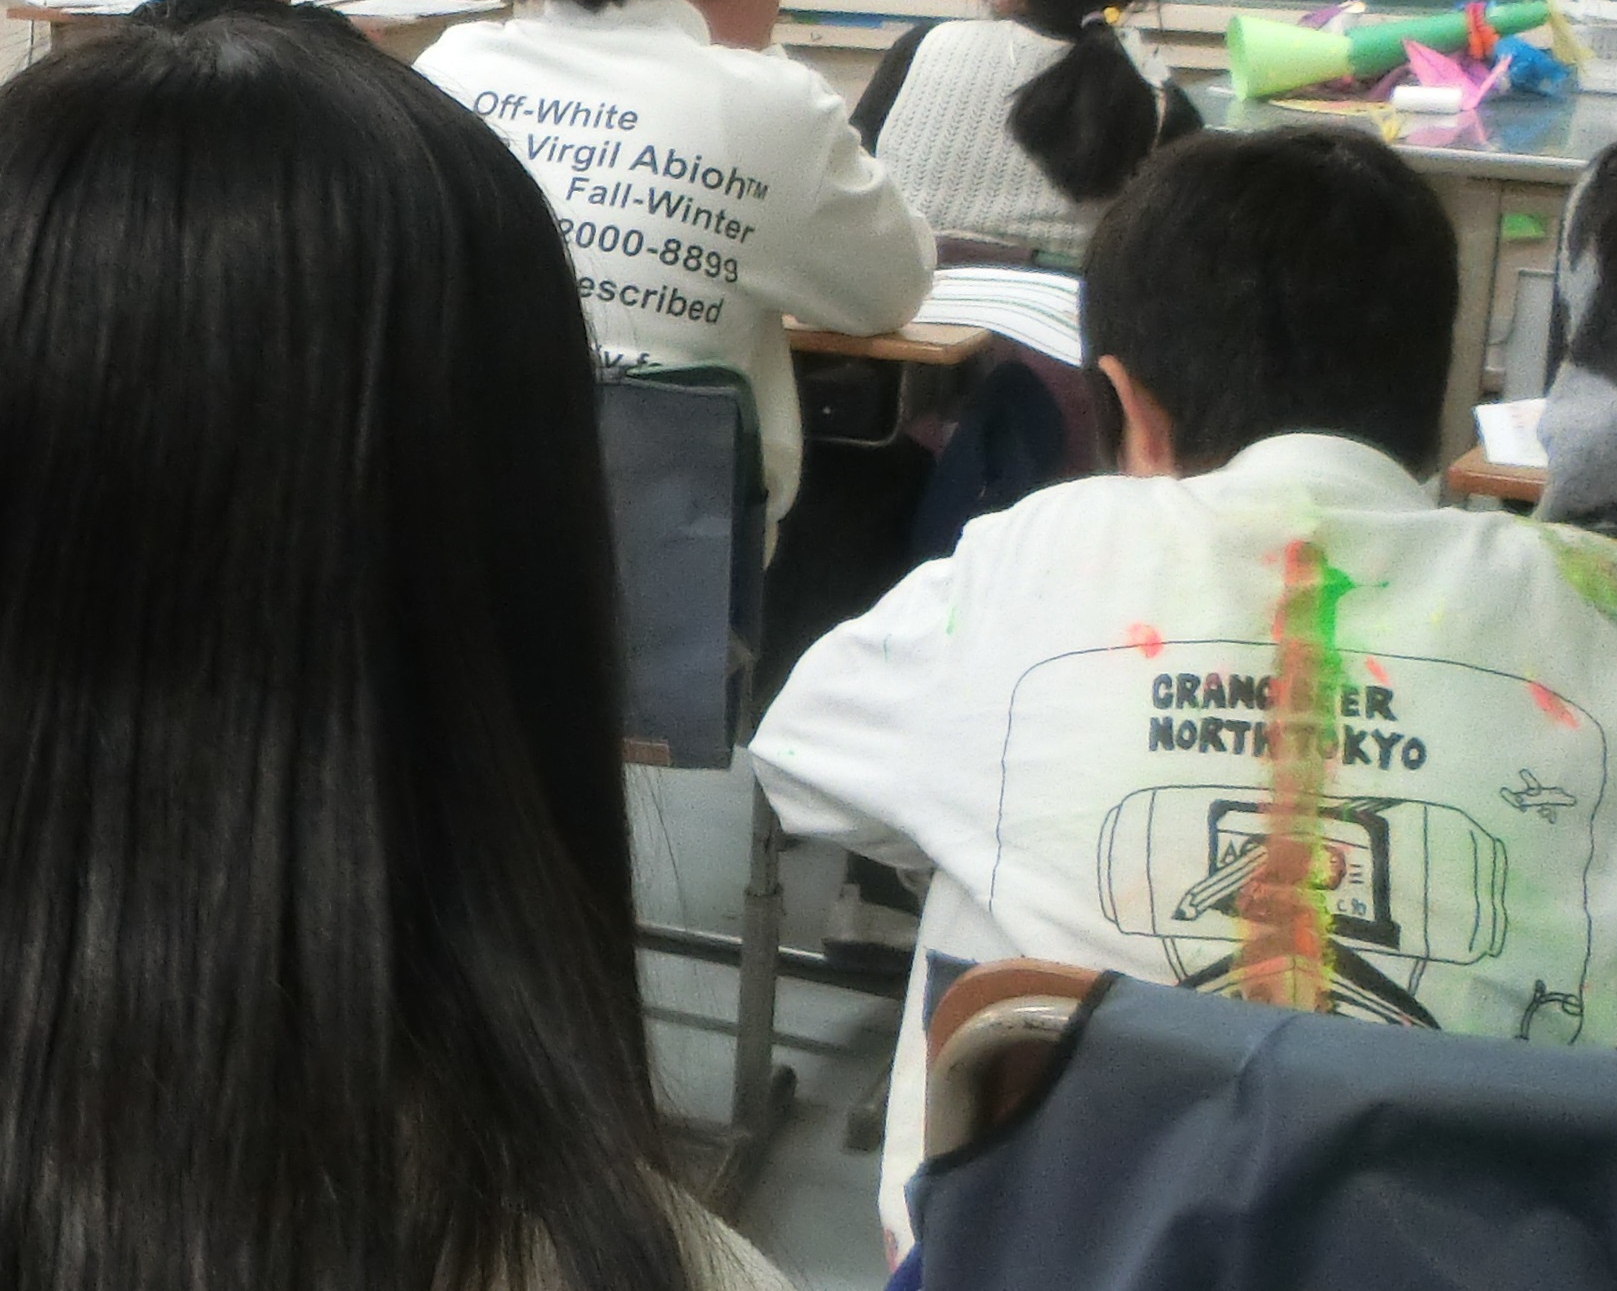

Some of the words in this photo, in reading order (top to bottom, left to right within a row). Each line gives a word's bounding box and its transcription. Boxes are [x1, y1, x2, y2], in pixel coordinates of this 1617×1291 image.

[473, 90, 639, 131] Off-White
[526, 133, 622, 172] Virgil
[565, 176, 756, 244] Fall-Winter
